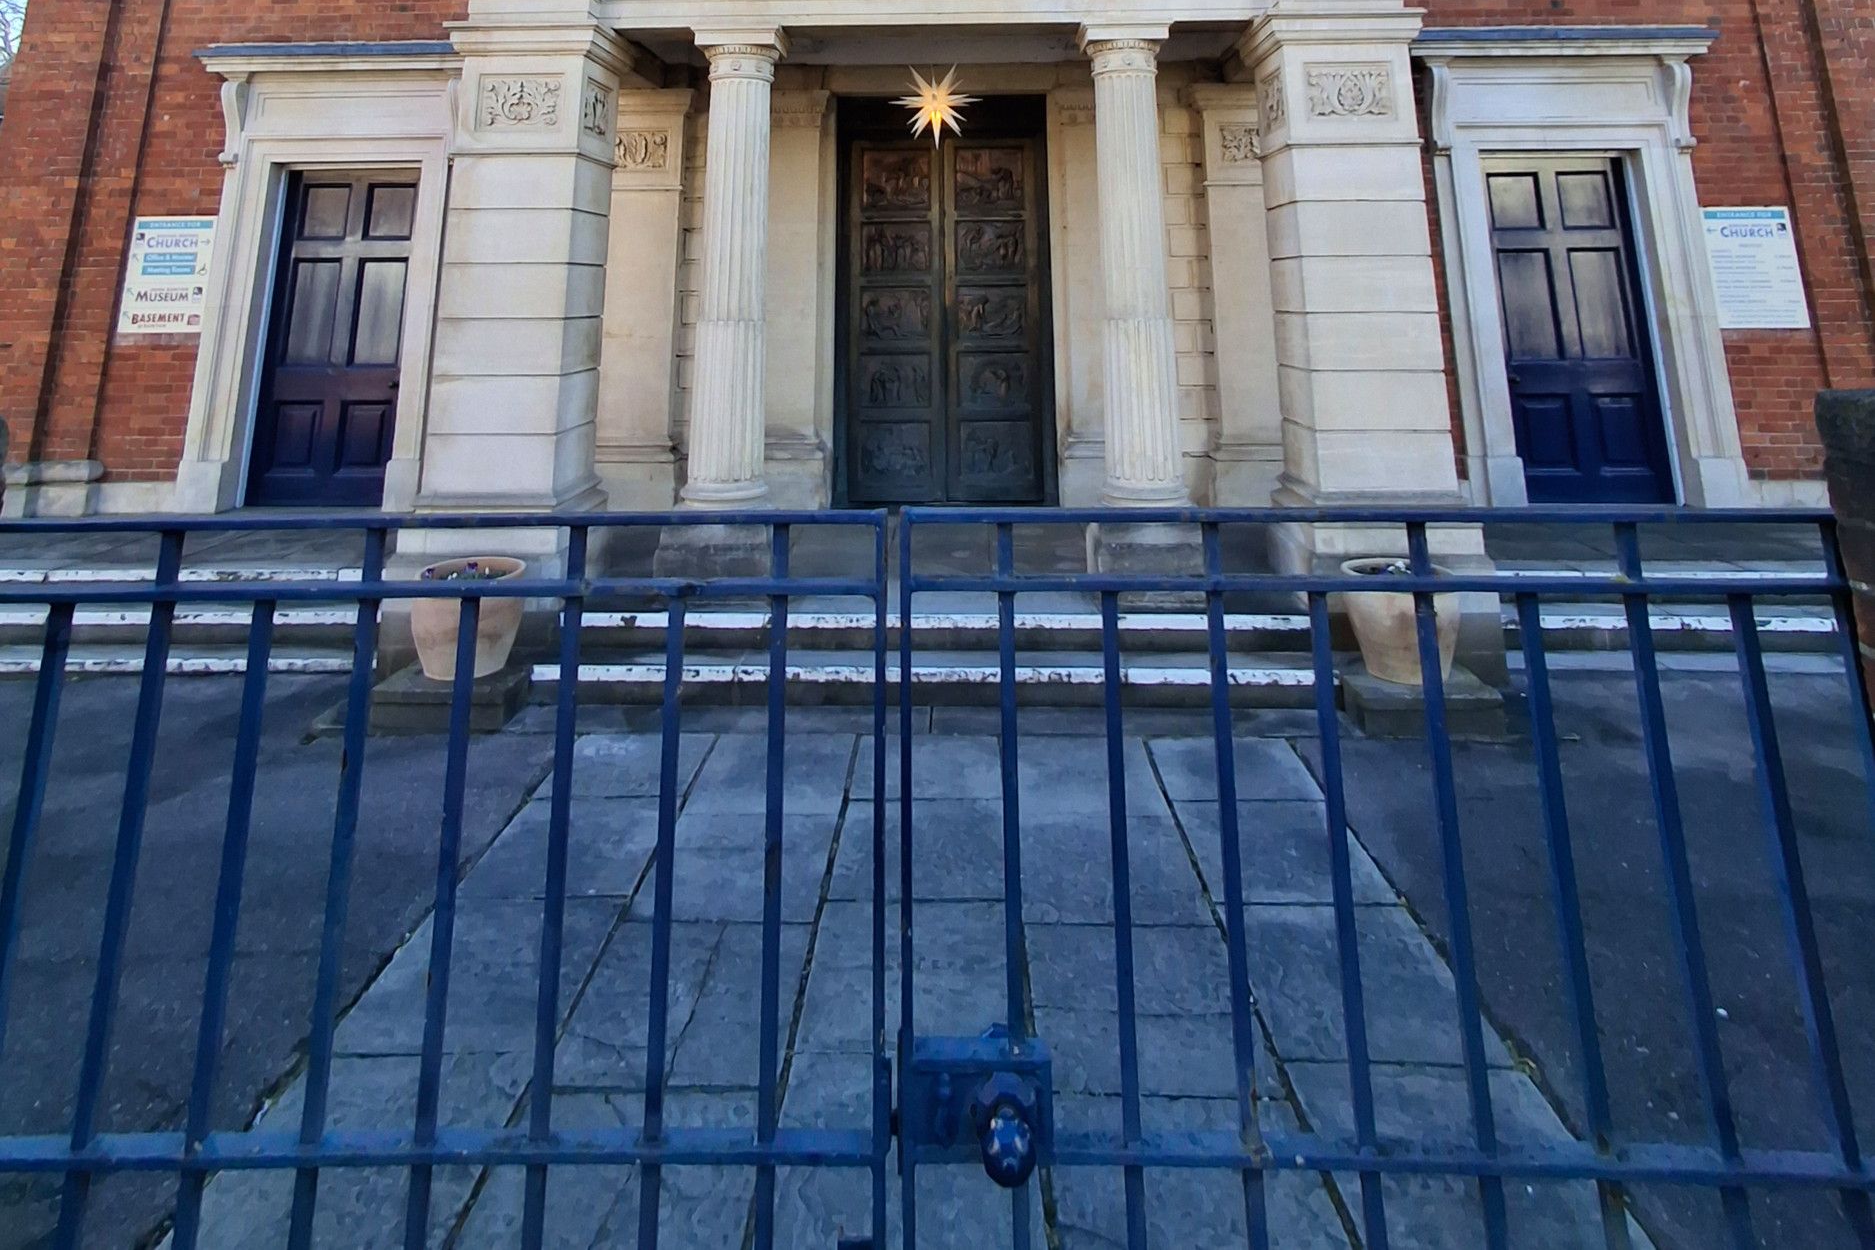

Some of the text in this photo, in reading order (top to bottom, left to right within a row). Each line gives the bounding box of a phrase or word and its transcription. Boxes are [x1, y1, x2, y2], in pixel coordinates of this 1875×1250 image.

[1720, 226, 1774, 238] CHURCH
[147, 237, 198, 248] CHURCH
[135, 291, 189, 302] MUSEUM
[131, 313, 185, 324] BASEMENT
